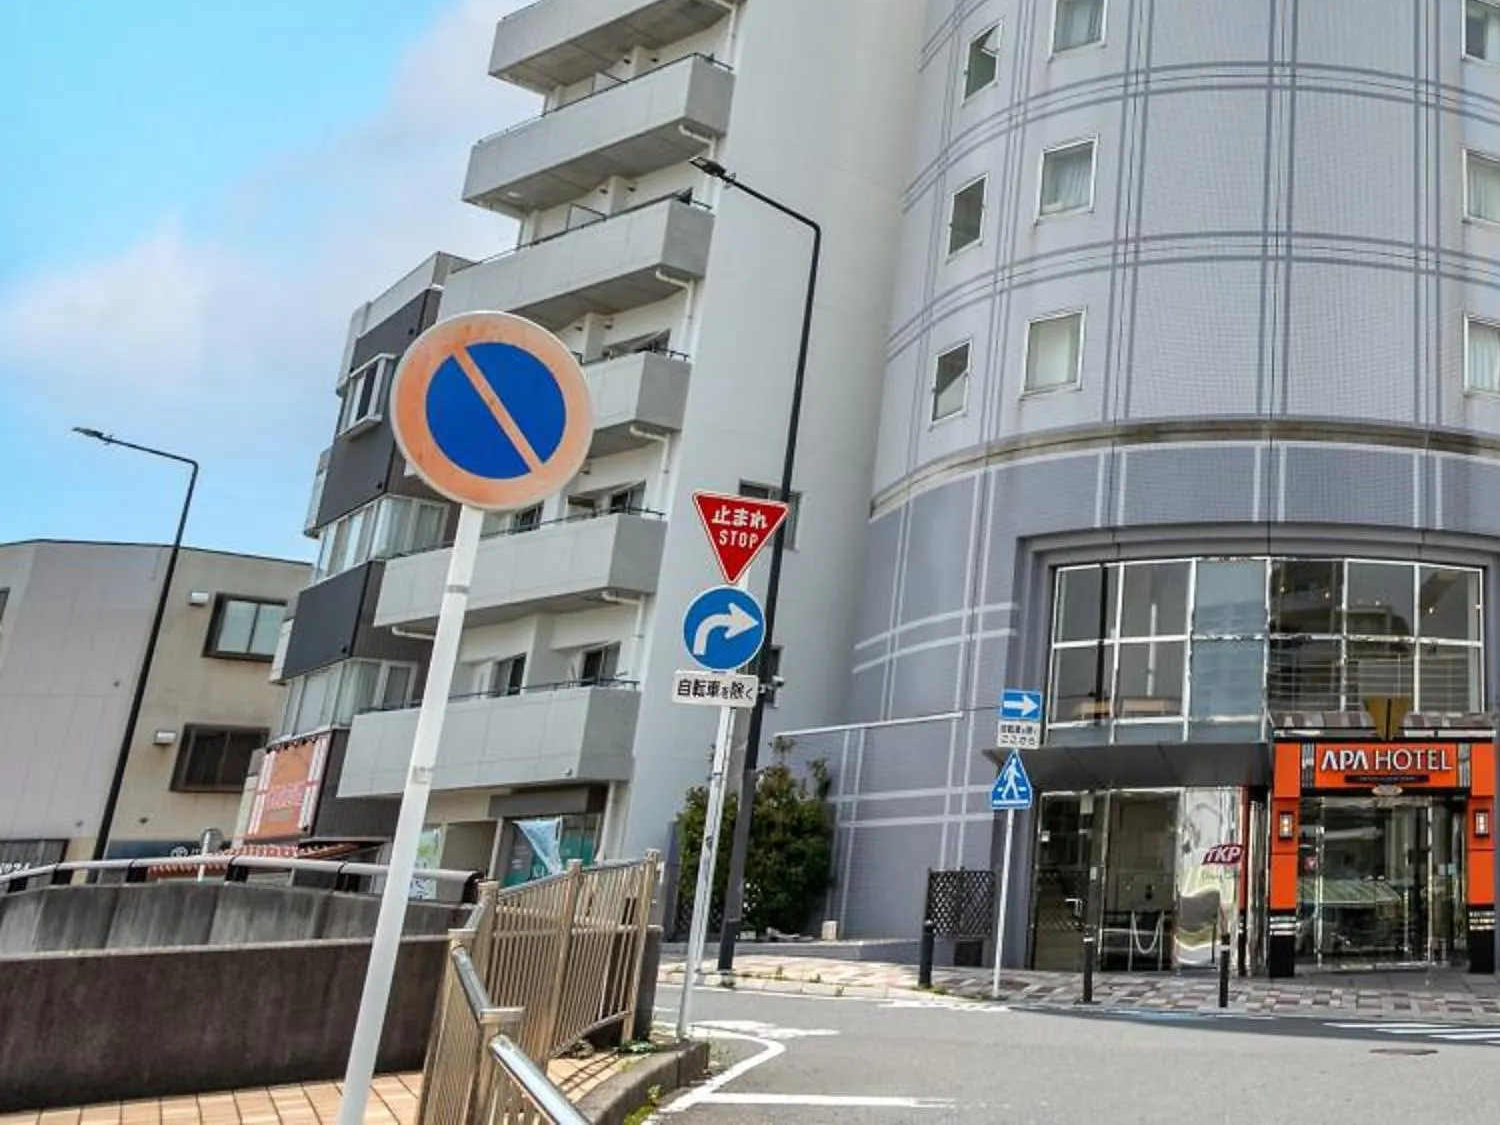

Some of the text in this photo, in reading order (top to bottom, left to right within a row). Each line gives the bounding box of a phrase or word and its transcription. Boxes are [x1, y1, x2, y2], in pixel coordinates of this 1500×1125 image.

[711, 504, 768, 530] 止まれ
[719, 529, 758, 549] STOP
[677, 678, 753, 700] 自転車を除く
[1321, 748, 1453, 771] APA HOTEL
[1206, 846, 1241, 863] TKP
